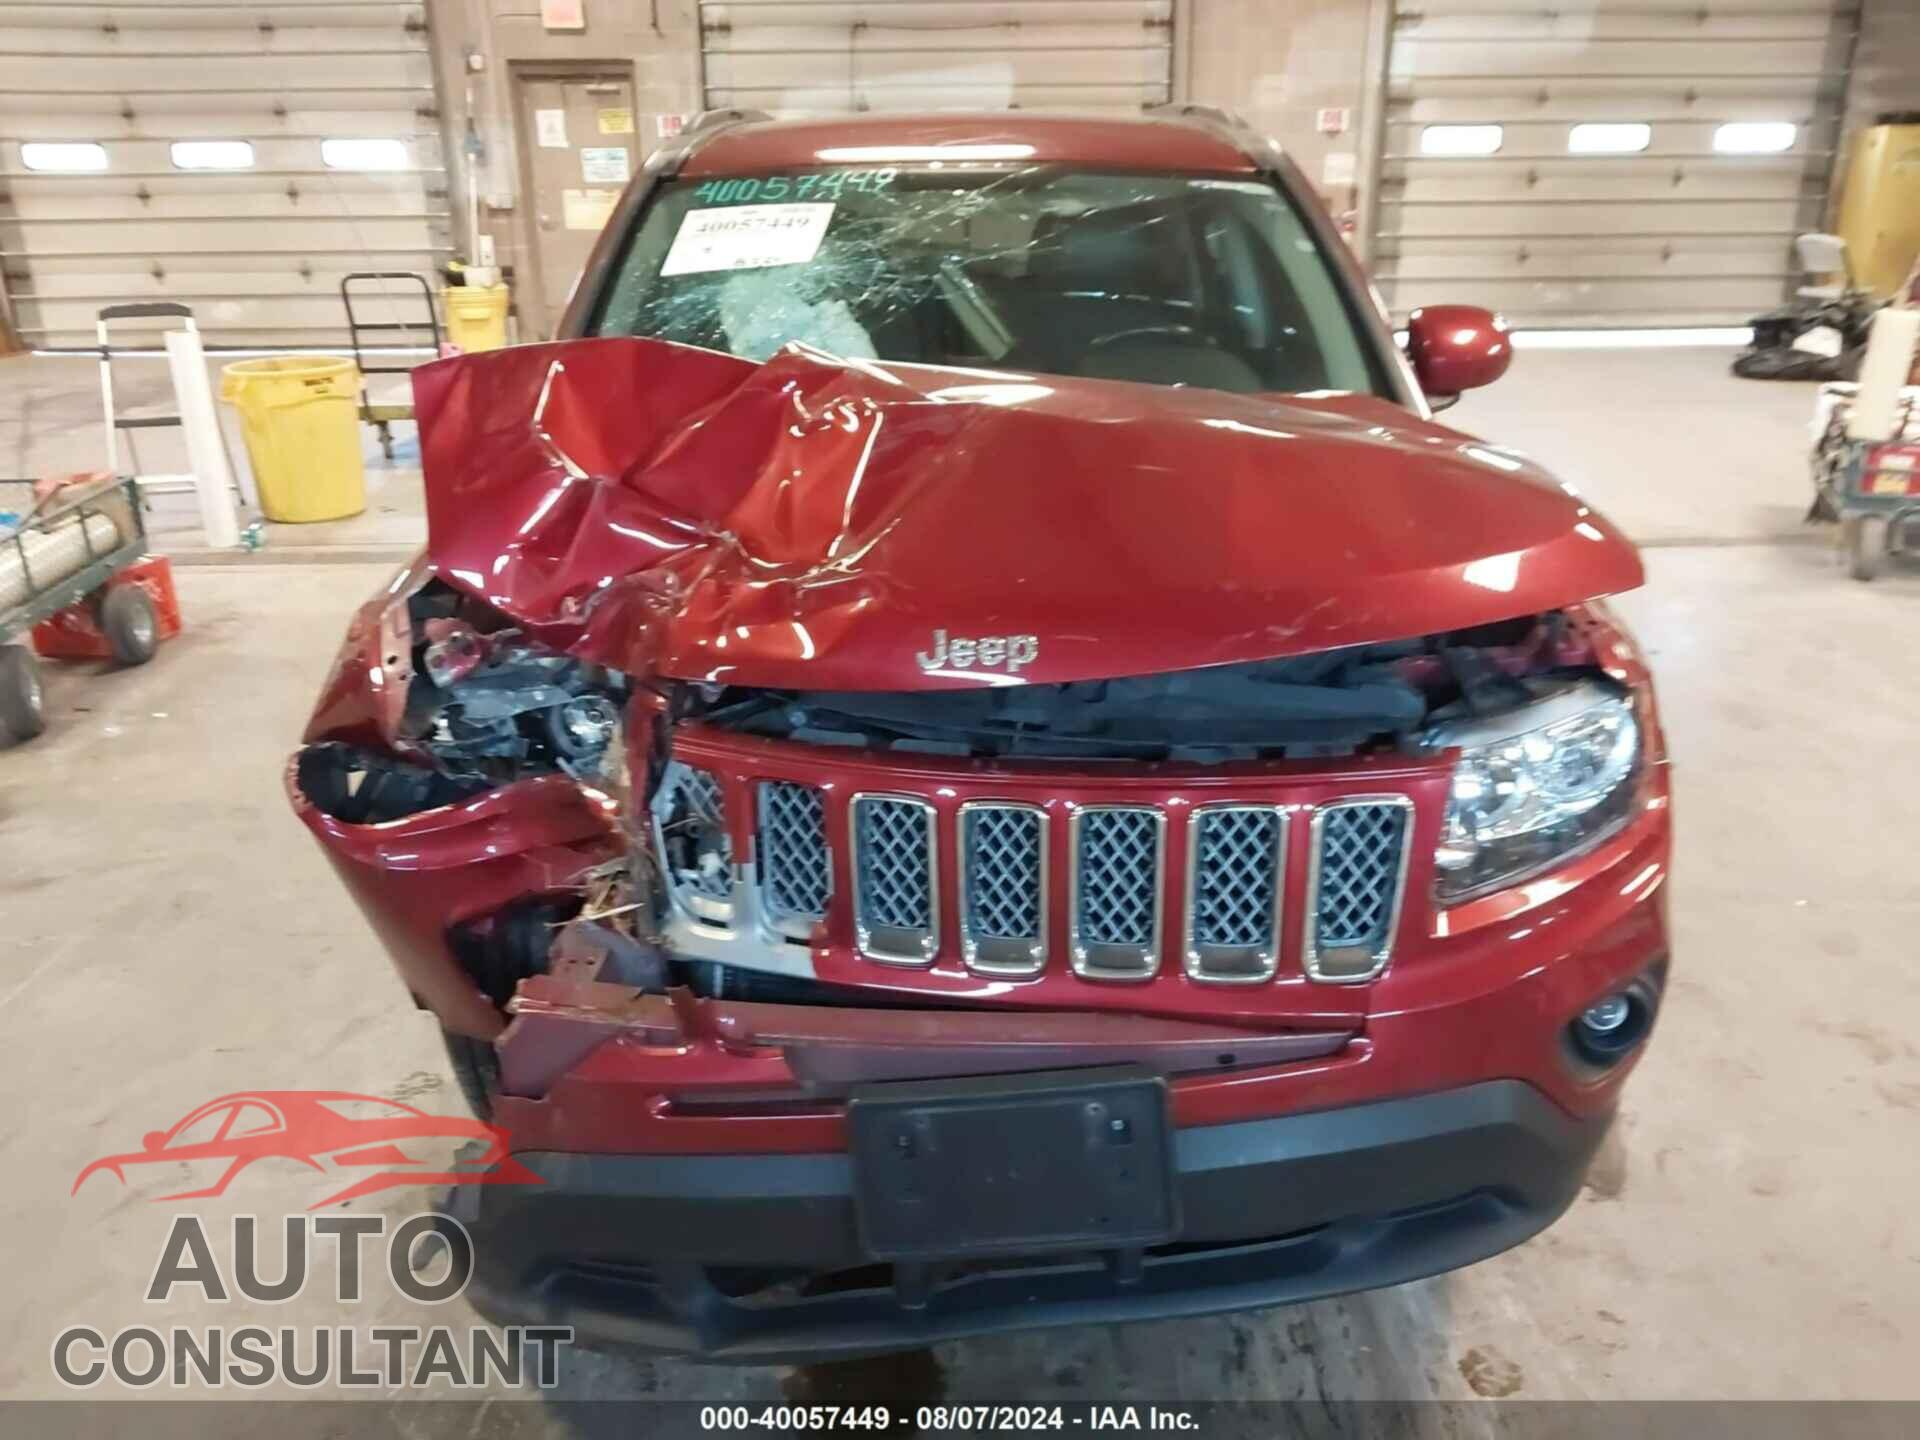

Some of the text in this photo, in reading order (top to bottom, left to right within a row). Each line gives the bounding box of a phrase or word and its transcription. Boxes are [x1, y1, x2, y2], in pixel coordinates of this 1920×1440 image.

[695, 167, 898, 204] 40057449
[695, 216, 812, 233] 40057449
[915, 628, 1040, 673] Jeep
